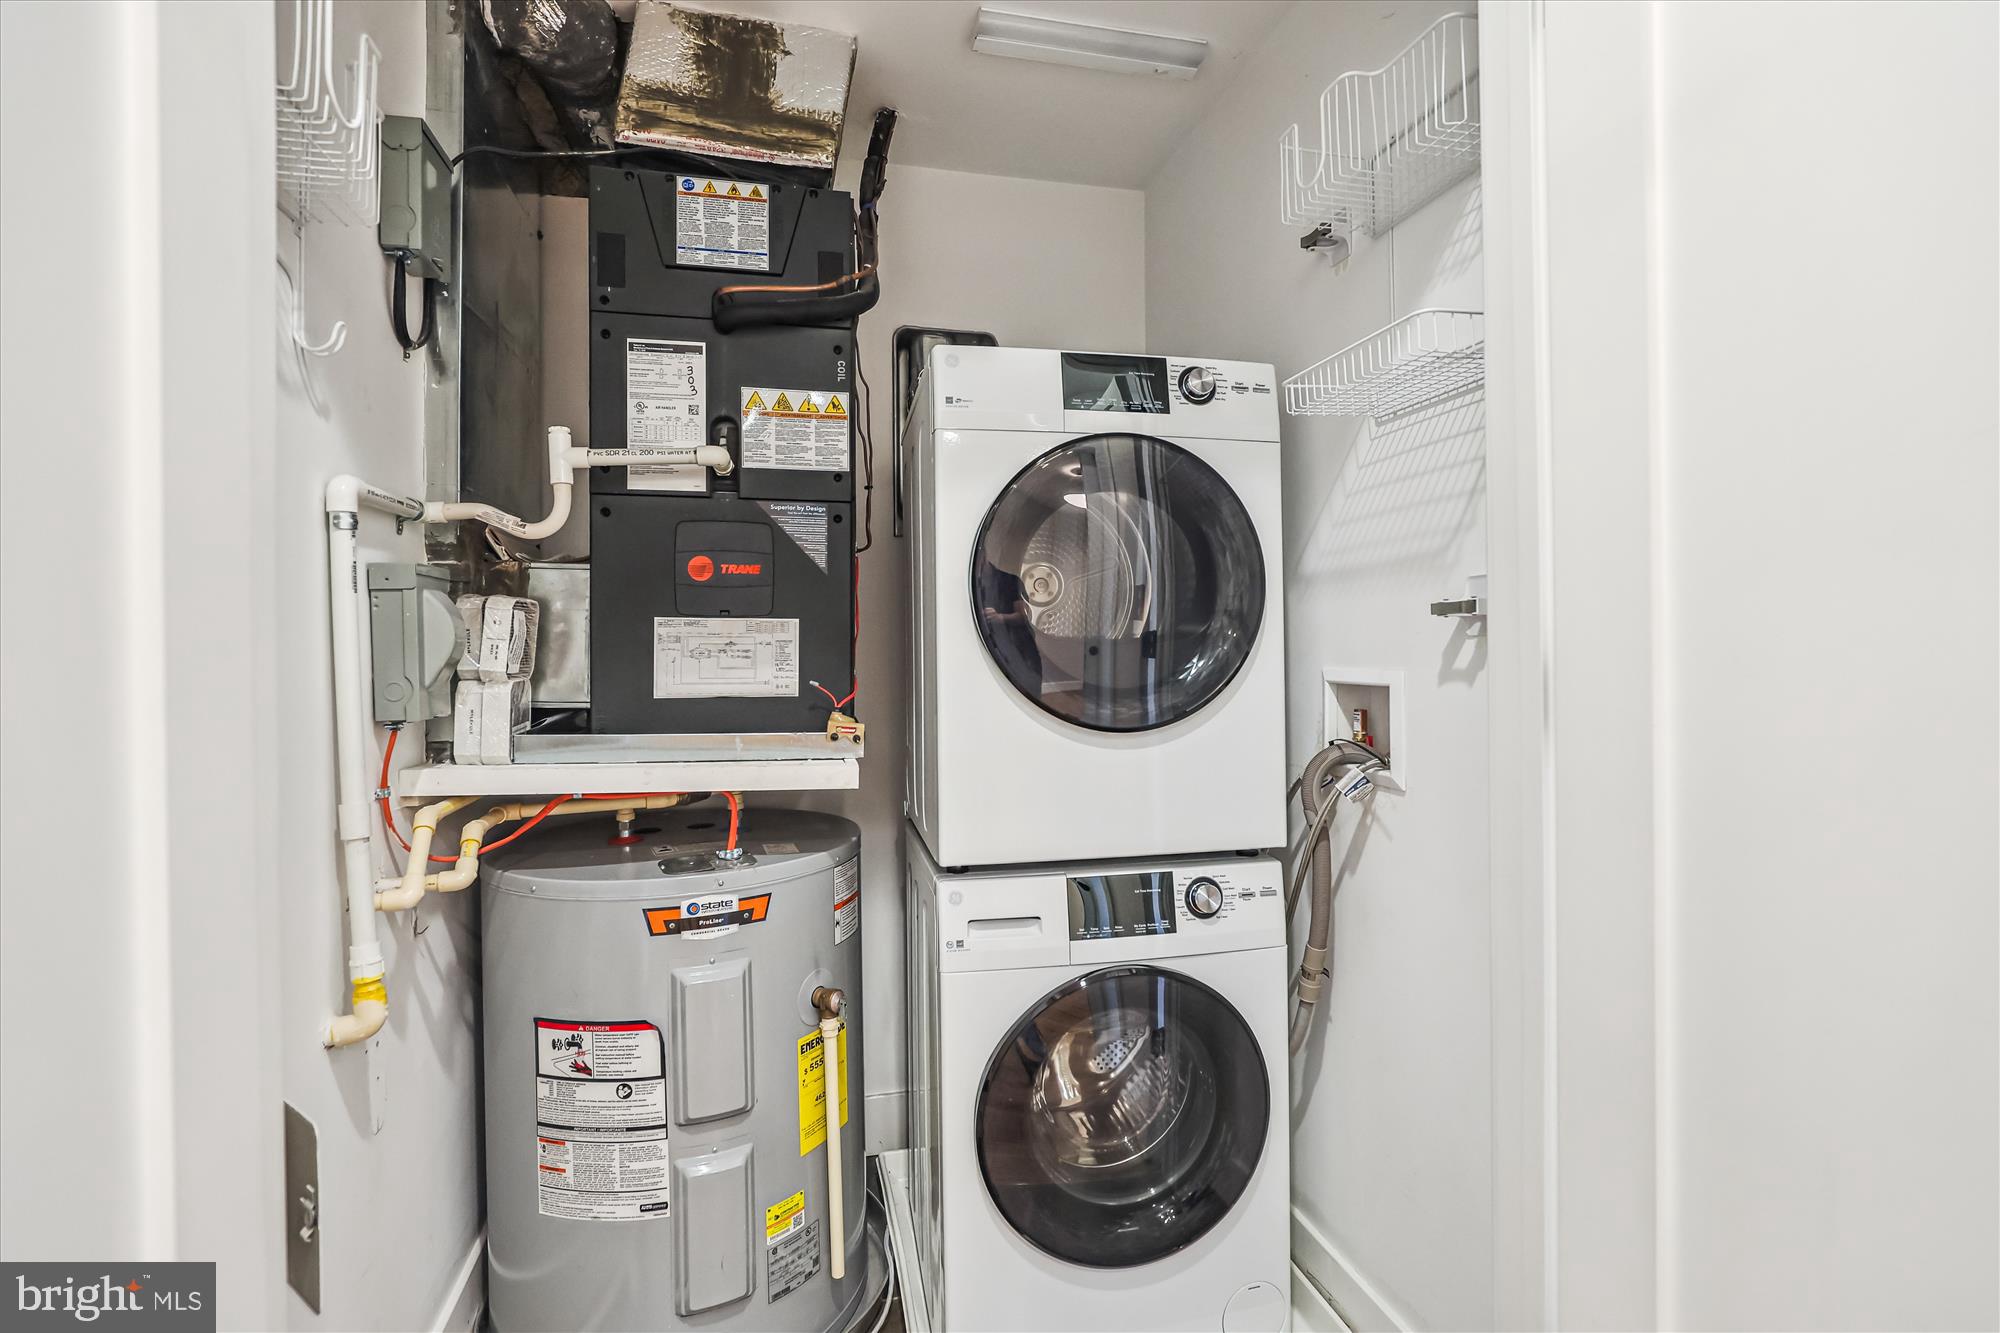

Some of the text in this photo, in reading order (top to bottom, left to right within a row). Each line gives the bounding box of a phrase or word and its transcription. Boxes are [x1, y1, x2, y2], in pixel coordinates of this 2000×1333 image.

[837, 360, 846, 382] COIL
[770, 503, 795, 511] Superior
[805, 505, 826, 513] Design
[720, 563, 761, 575] TRANE
[701, 899, 733, 911] state
